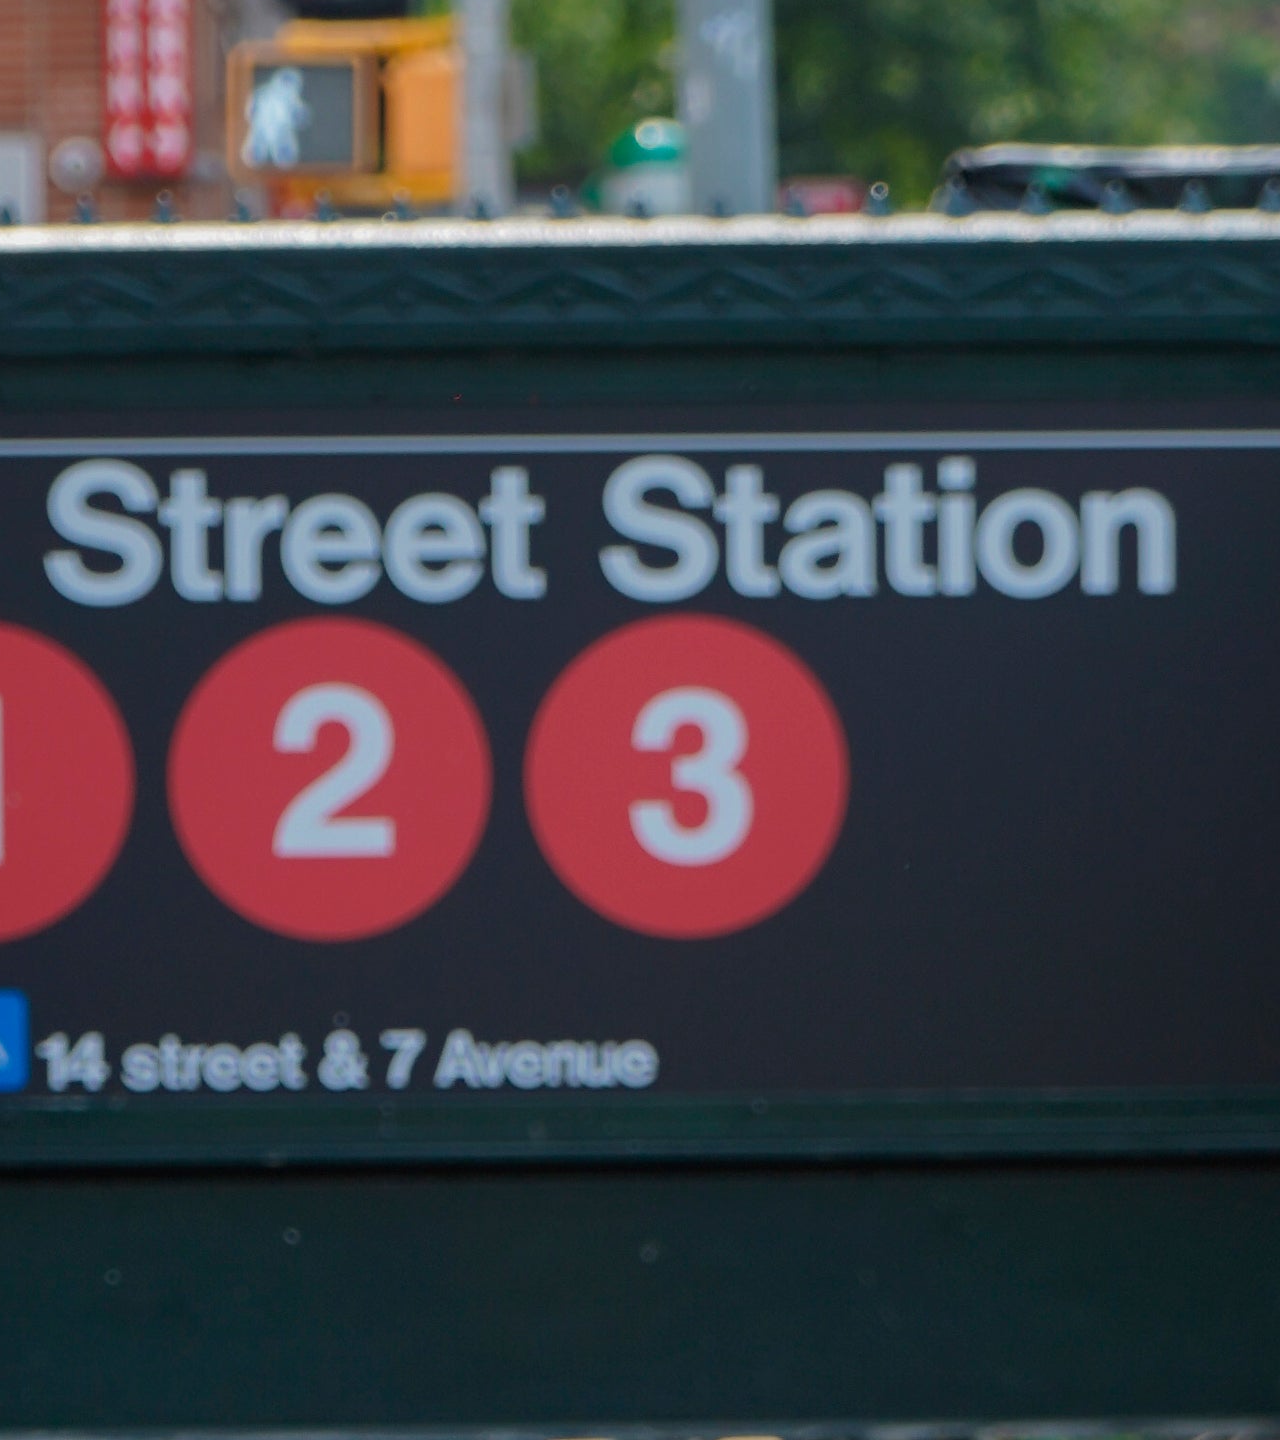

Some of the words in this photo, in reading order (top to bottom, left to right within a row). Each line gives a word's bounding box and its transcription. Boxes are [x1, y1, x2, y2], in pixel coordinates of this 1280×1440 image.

[43, 456, 547, 606] Street
[597, 452, 1178, 602] Station
[270, 680, 398, 860] 2
[627, 685, 755, 868] 3
[37, 1030, 109, 1091] 14
[121, 1033, 305, 1091] street
[317, 1028, 370, 1089] &
[378, 1028, 426, 1088] 7
[433, 1029, 659, 1089] Avenue
